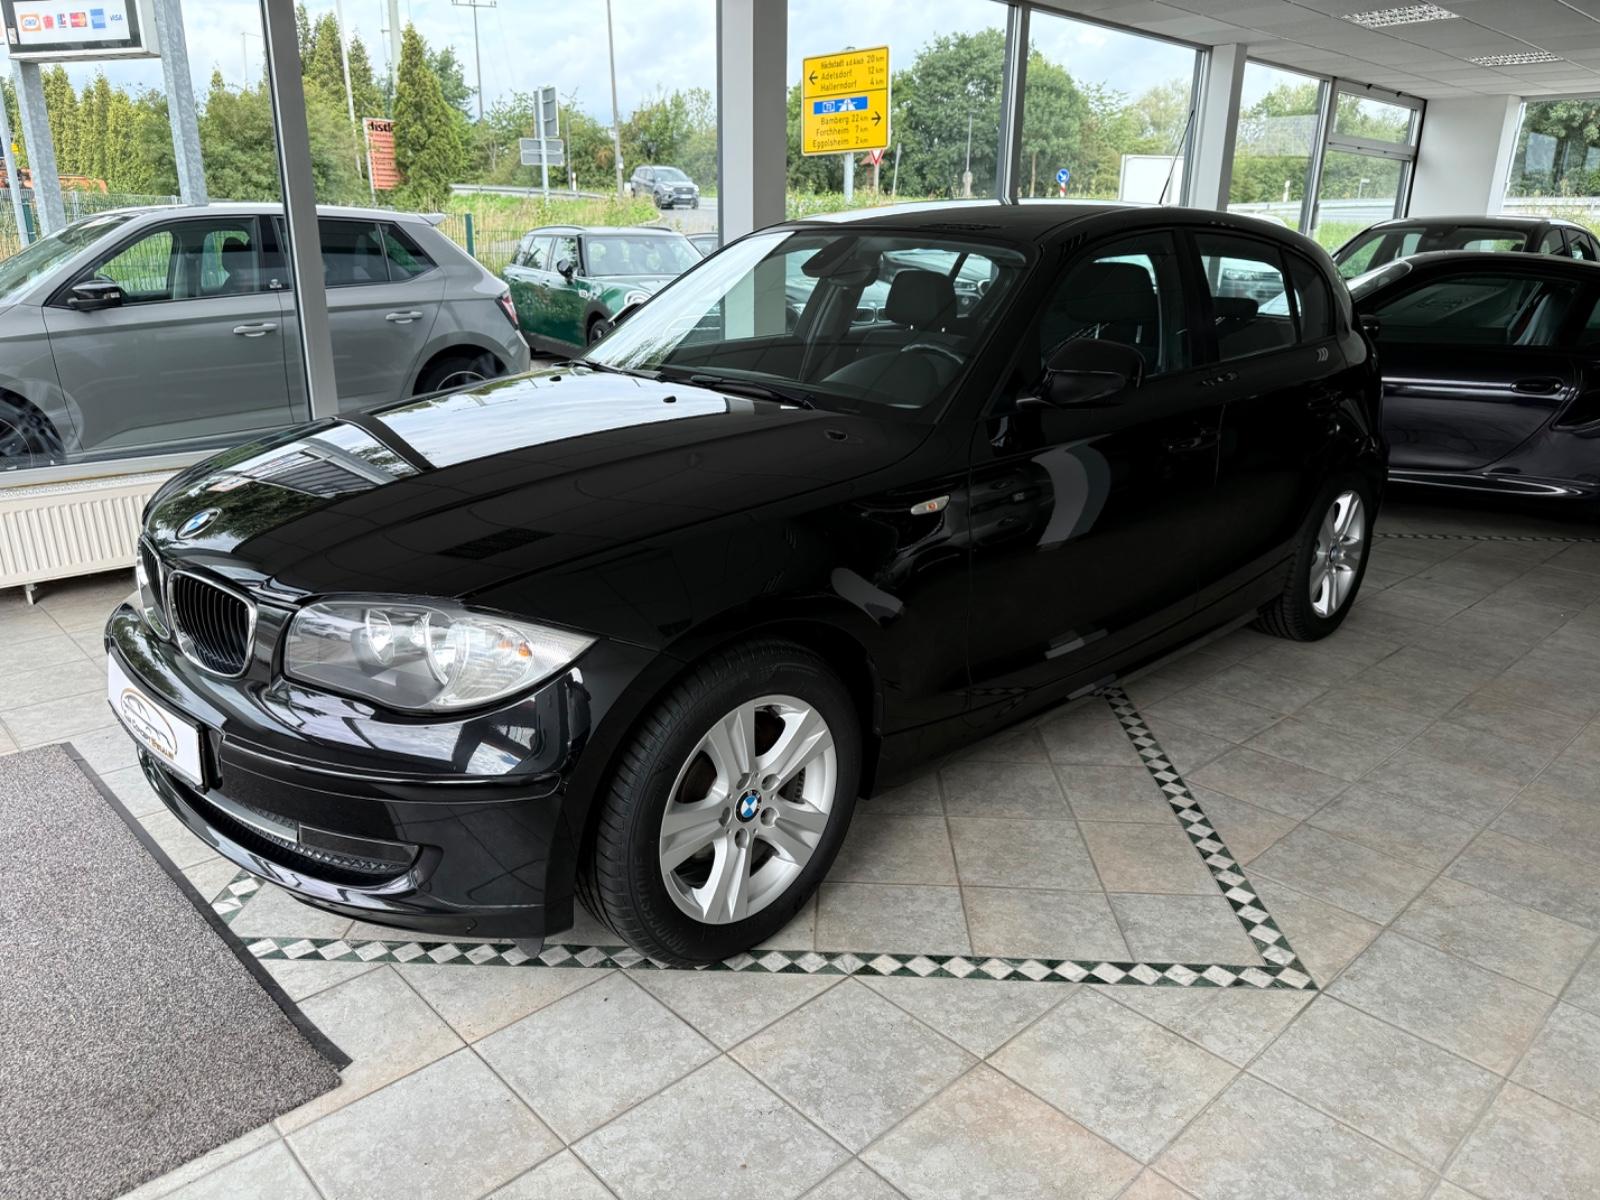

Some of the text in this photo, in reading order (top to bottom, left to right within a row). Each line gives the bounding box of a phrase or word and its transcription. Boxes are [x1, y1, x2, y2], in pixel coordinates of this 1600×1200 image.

[866, 55, 875, 64] 20
[821, 69, 852, 80] Adelsdorf
[868, 66, 875, 75] 12
[821, 80, 856, 91] Hallerndorf
[821, 116, 849, 126] Bamberg
[852, 114, 860, 122] 22
[816, 128, 849, 136] Forchheim
[812, 139, 849, 149] Eggolsheim
